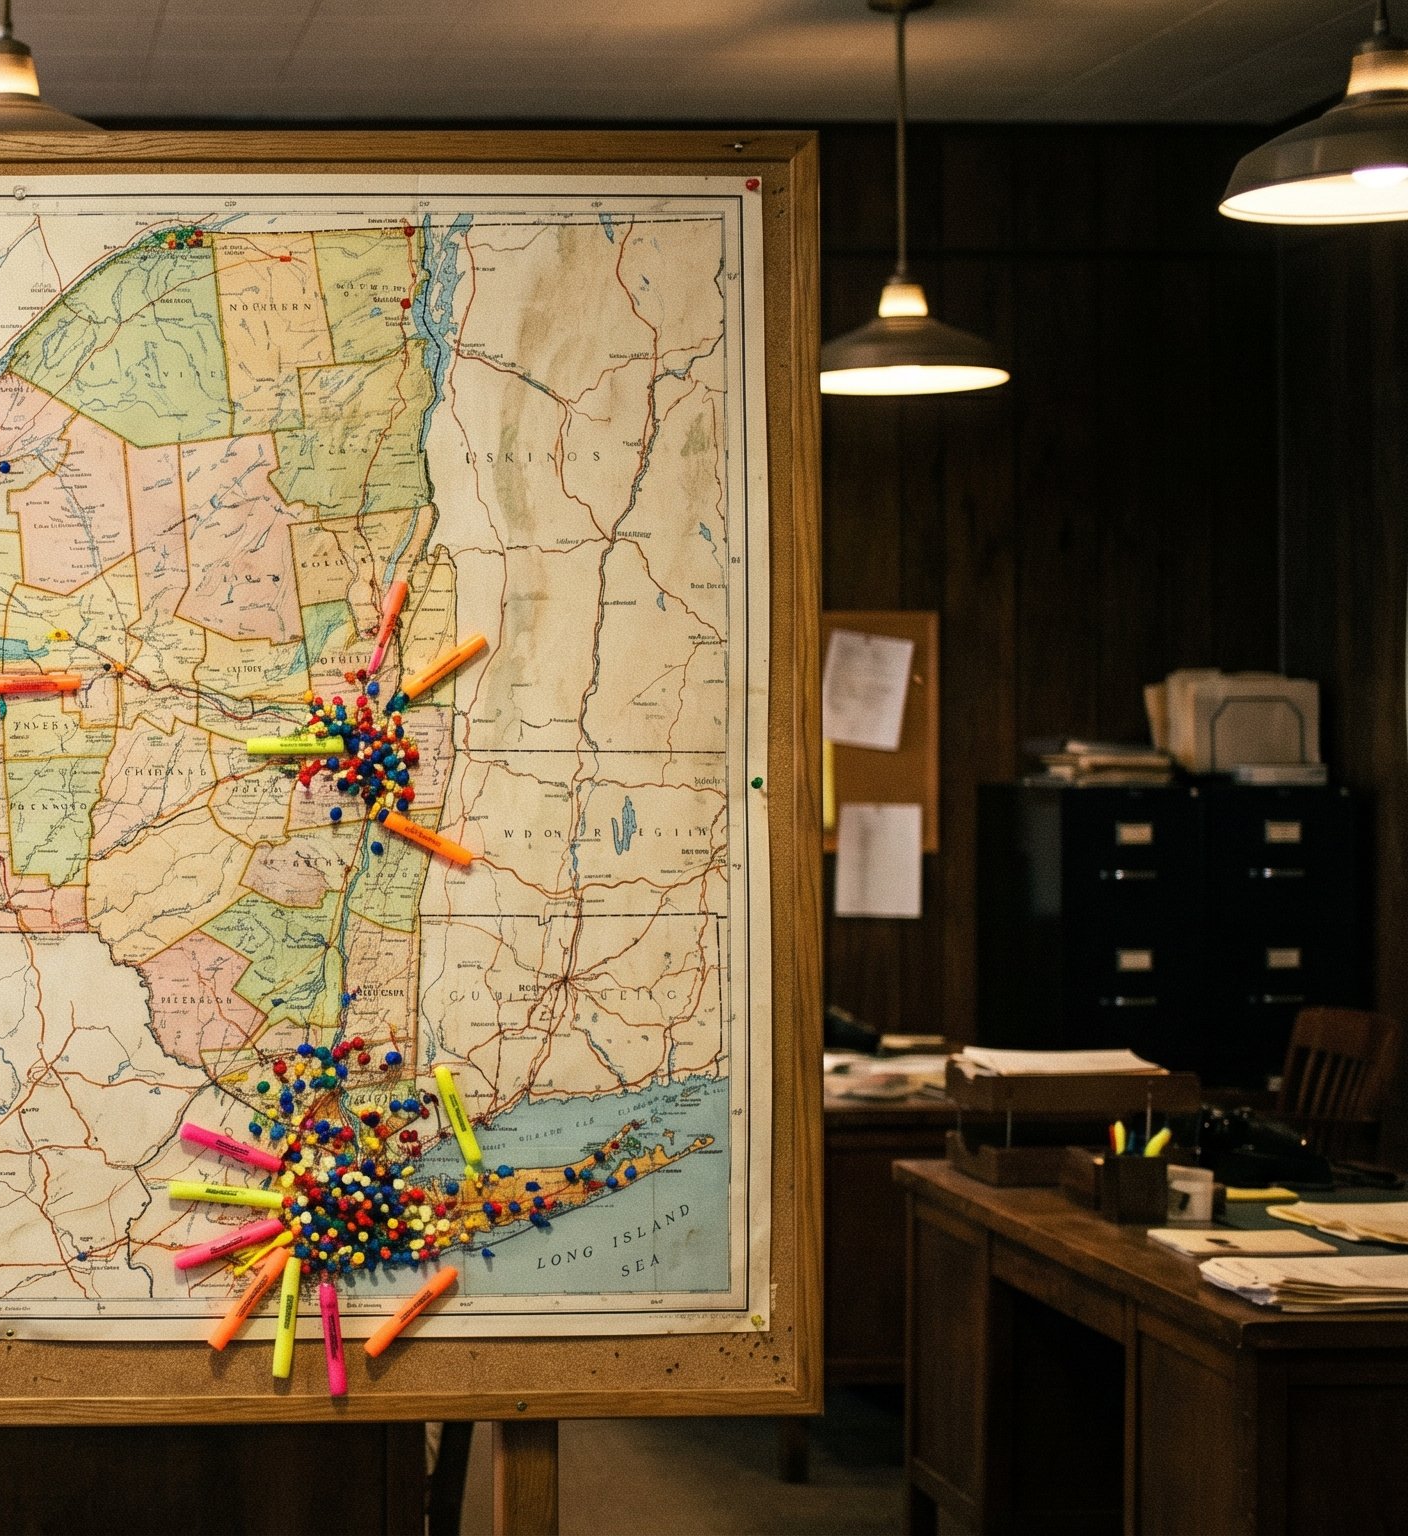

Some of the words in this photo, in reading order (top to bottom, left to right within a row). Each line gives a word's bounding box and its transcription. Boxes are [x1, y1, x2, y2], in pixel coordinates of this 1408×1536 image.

[536, 1245, 593, 1270] LONG
[611, 1204, 691, 1248] ISLAND
[621, 1253, 660, 1278] SEA
